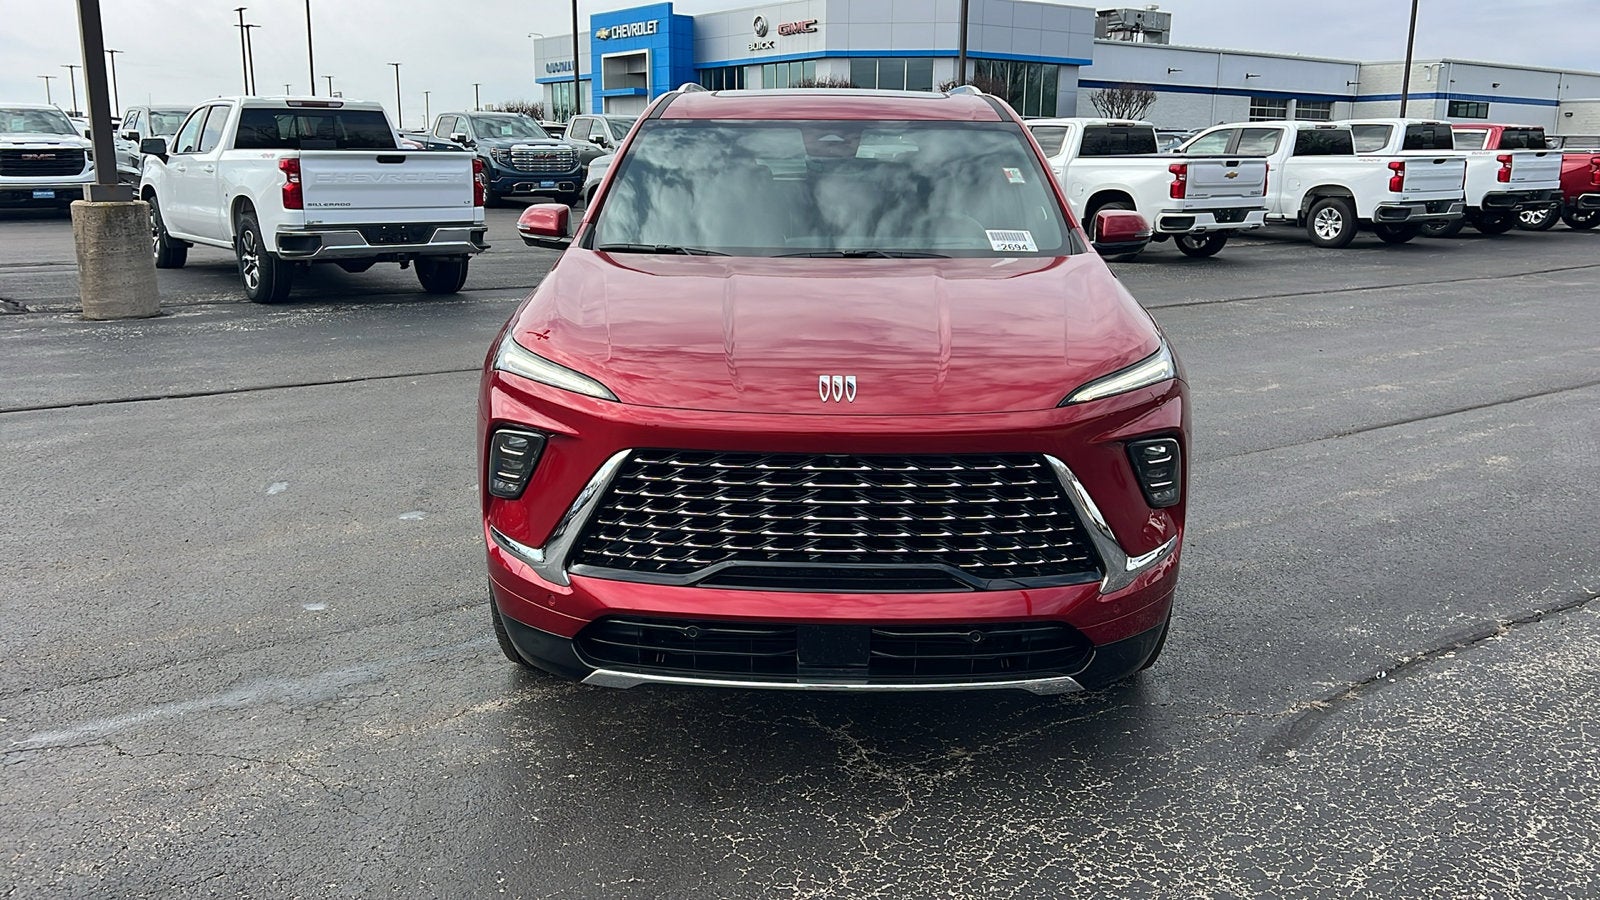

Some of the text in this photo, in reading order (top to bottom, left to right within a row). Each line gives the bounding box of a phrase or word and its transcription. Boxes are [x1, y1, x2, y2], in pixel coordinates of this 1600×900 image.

[611, 19, 659, 39] CHEVROLET
[777, 19, 818, 36] GMC
[748, 41, 775, 51] BUICK
[314, 171, 464, 185] CHEVROLET
[1000, 243, 1028, 251] 2694
